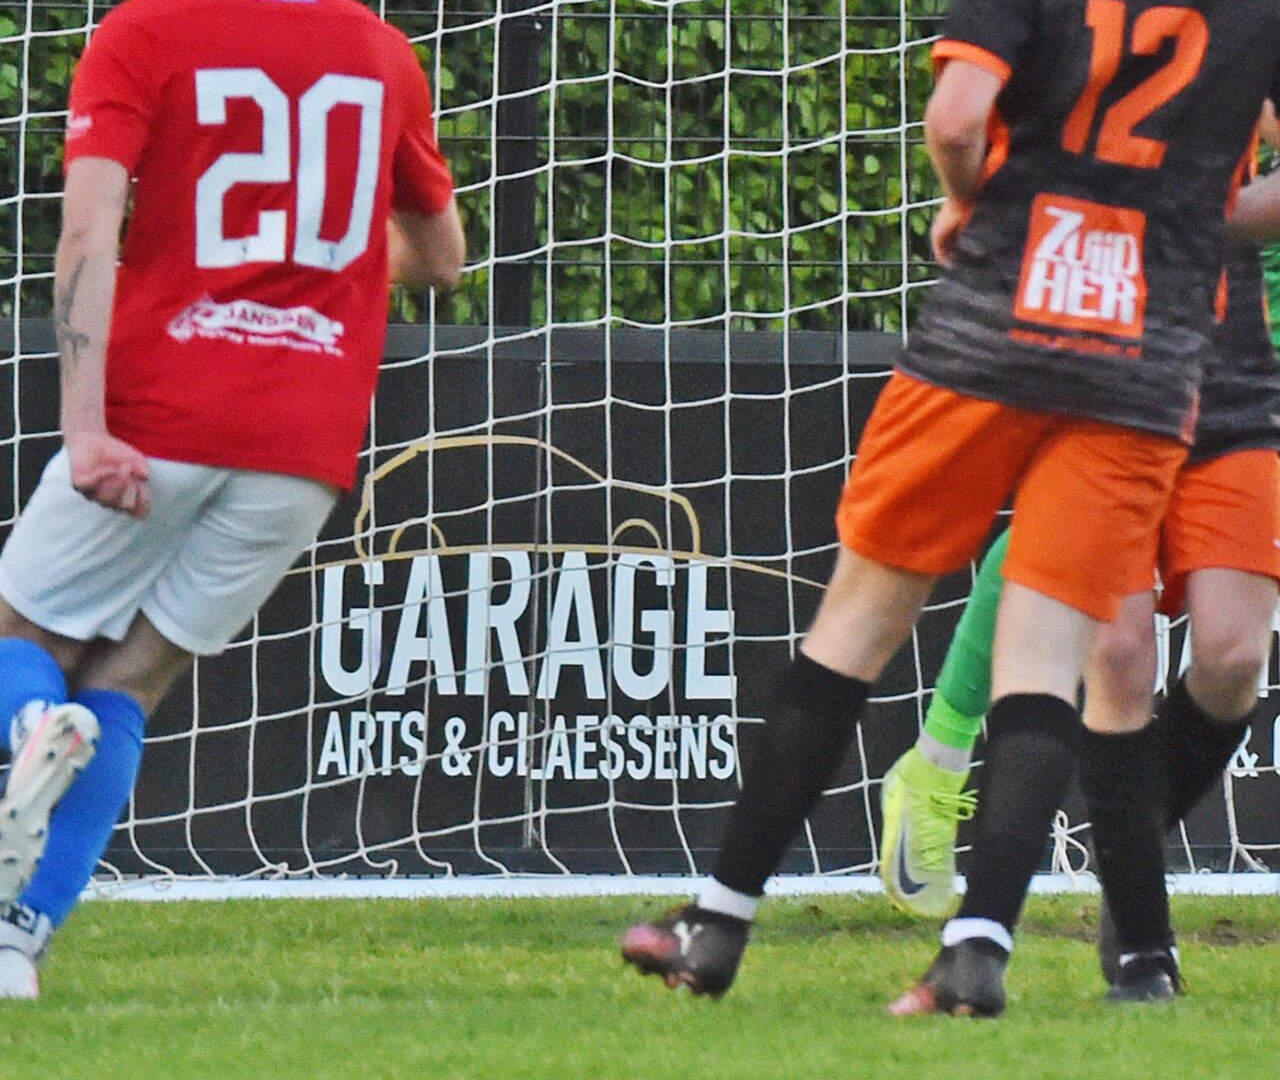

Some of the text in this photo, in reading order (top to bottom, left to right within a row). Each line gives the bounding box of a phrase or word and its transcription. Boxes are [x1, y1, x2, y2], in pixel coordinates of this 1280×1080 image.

[194, 67, 385, 272] 20
[320, 550, 738, 700] GARAGE
[318, 709, 738, 781] ARTS & CLAESSENS
